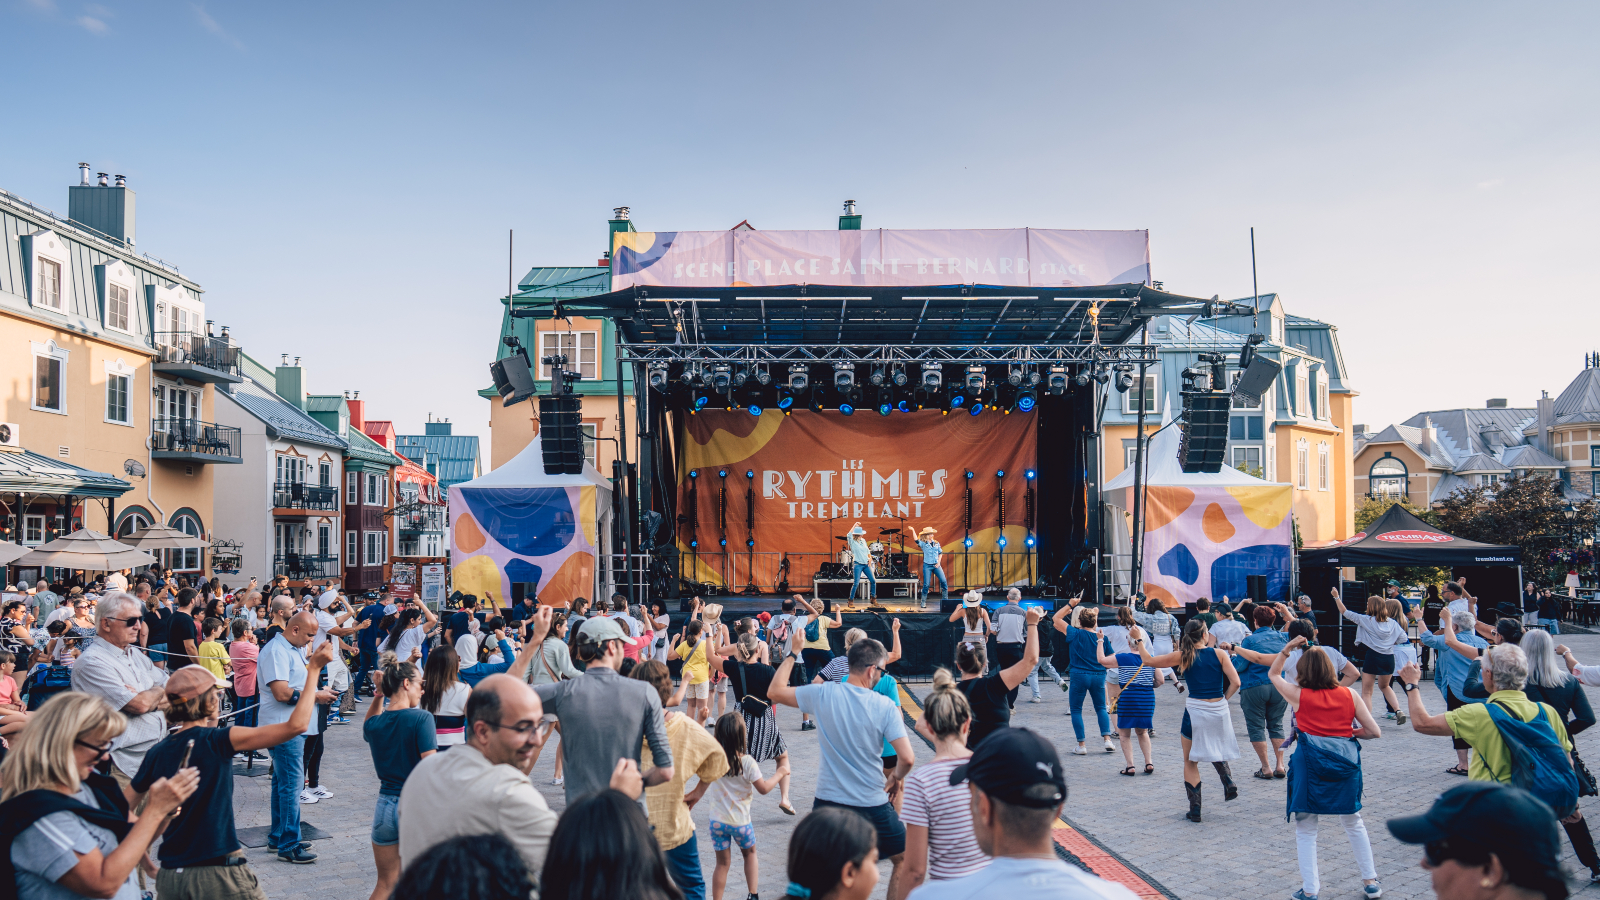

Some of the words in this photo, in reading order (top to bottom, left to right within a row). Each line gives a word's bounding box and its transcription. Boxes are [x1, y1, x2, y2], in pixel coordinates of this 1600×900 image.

[673, 257, 737, 278] SCÈNE
[747, 258, 821, 276] PLACE
[830, 257, 1030, 275] SAINT-BERNARD
[1040, 263, 1086, 276] STAGE
[842, 459, 864, 470] LES
[762, 468, 948, 499] RYTHMES
[786, 501, 924, 518] TREMBLANT
